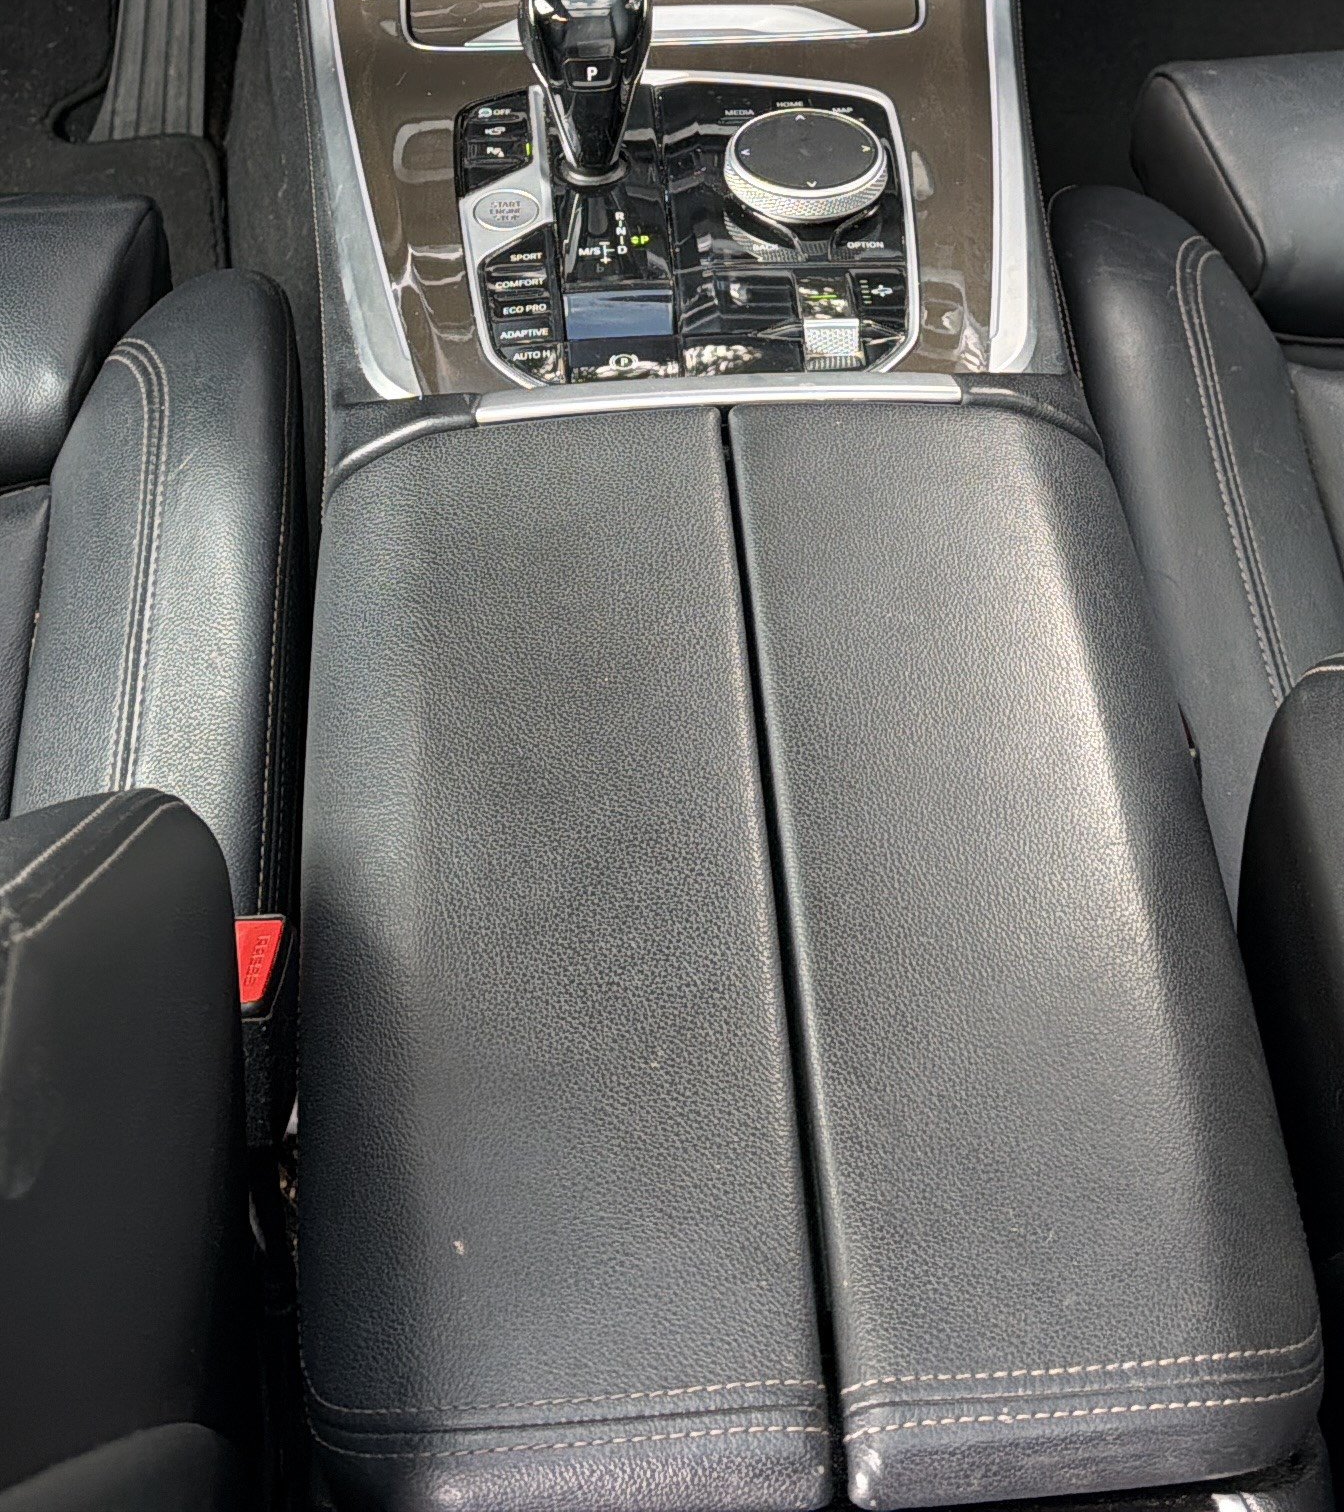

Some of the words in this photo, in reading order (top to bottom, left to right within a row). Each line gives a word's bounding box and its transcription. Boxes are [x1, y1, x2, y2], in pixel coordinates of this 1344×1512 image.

[586, 66, 598, 81] P
[490, 200, 521, 208] START
[614, 211, 625, 221] R
[616, 226, 627, 236] N
[640, 235, 650, 245] P
[847, 241, 885, 249] OPTION
[578, 246, 601, 256] M/S
[617, 245, 628, 255] D
[510, 252, 543, 262] SPORT
[495, 278, 544, 289] COMFORT
[502, 306, 524, 316] ECO
[525, 303, 547, 313] PRO
[500, 328, 549, 339] ADAPTIVE
[513, 350, 541, 362] AUTO
[542, 350, 551, 358] H
